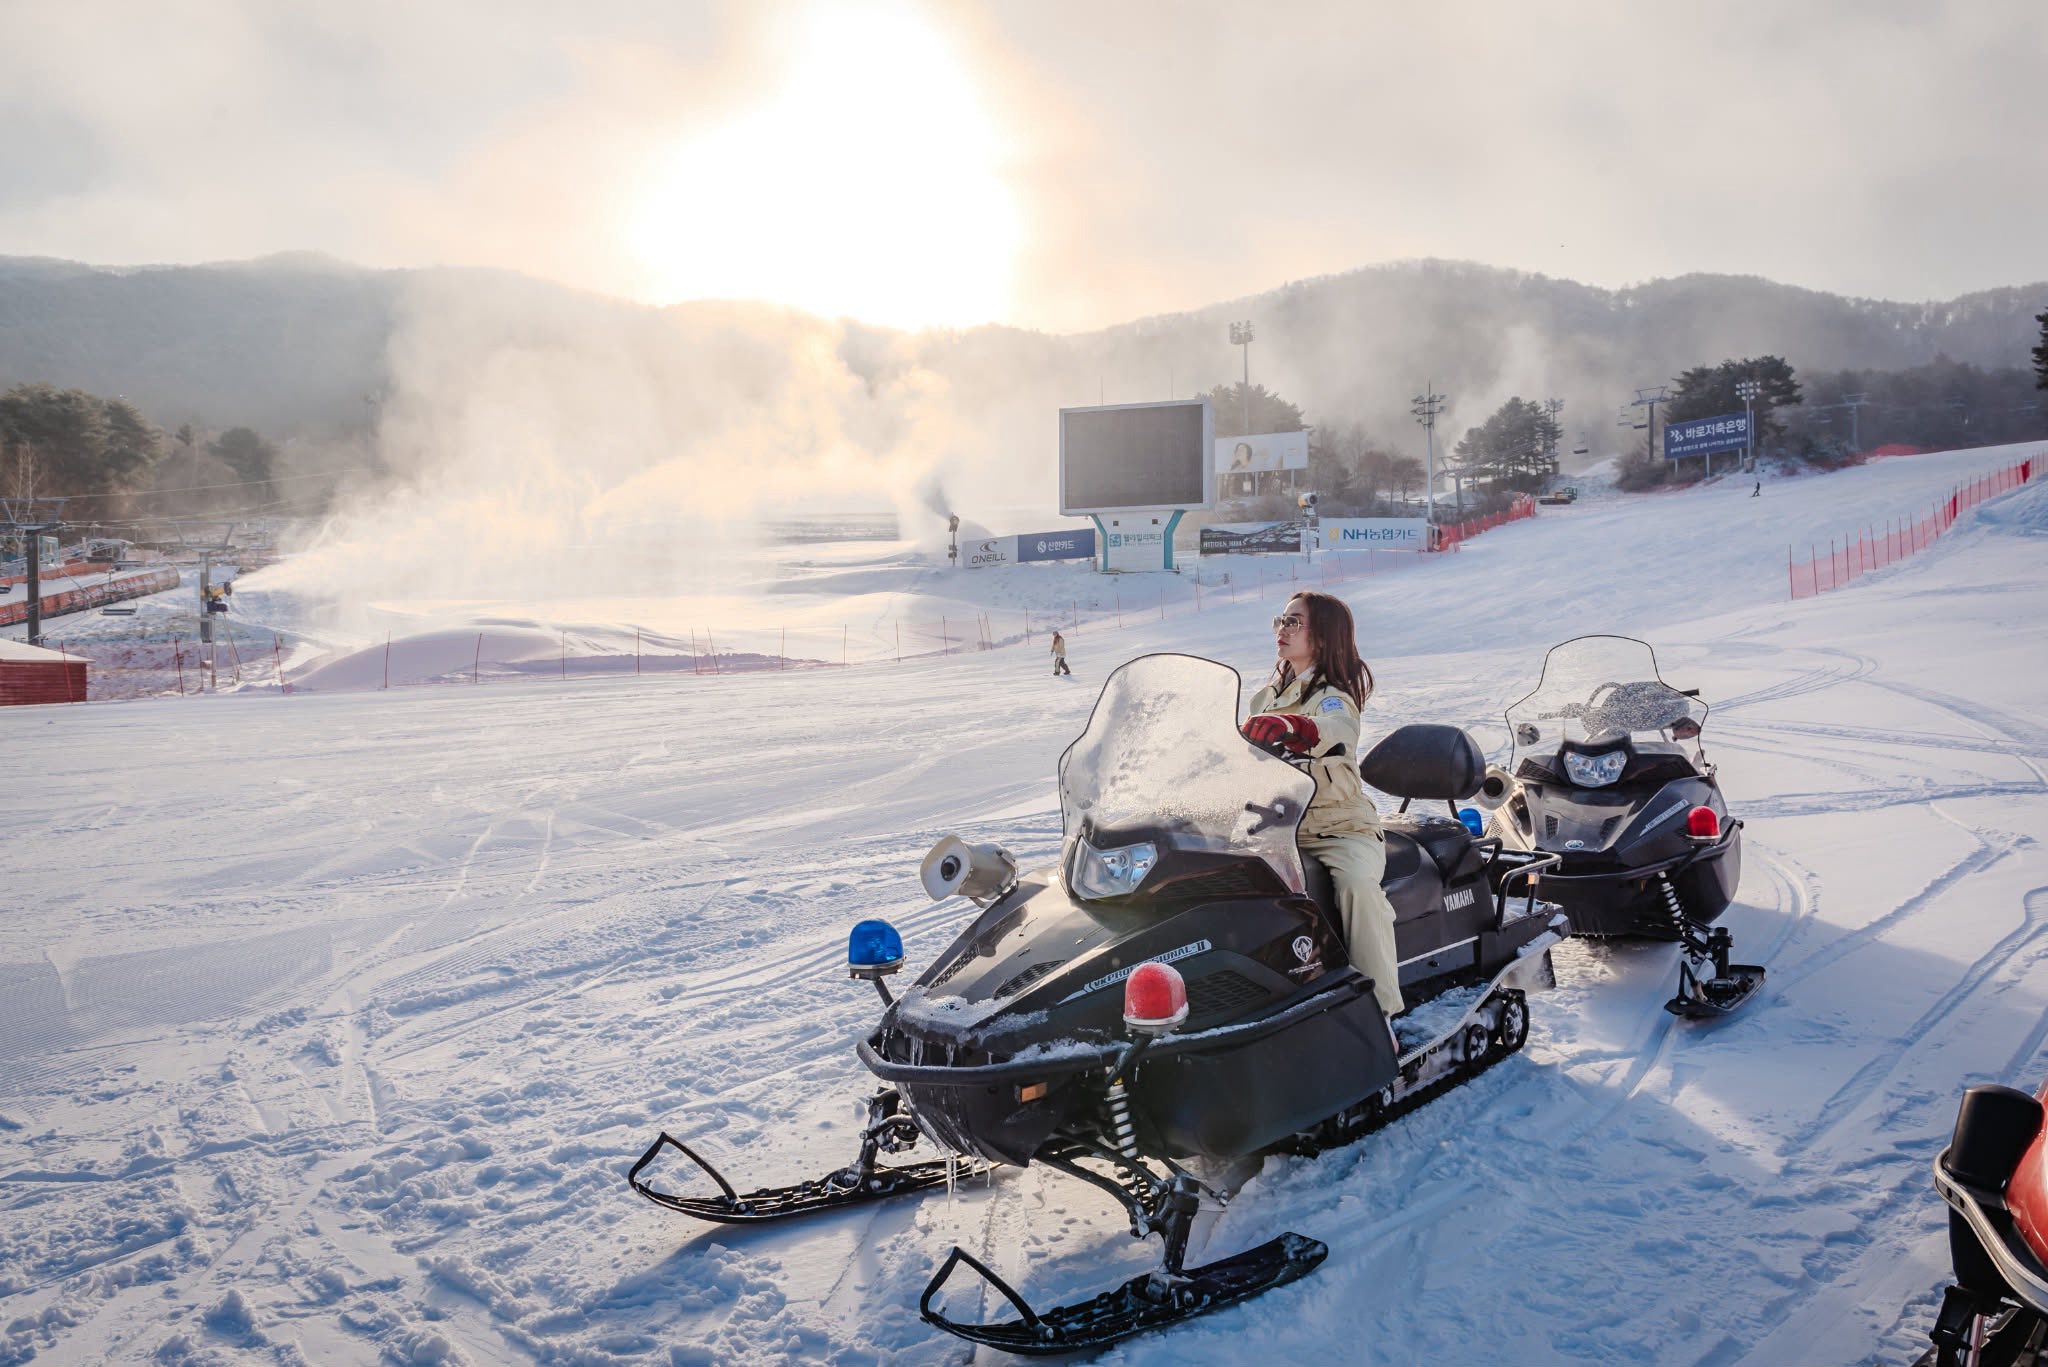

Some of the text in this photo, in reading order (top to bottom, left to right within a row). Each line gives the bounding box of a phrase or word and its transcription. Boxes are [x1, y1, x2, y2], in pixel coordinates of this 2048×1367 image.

[1685, 418, 1746, 439] 바로저축은행
[1343, 528, 1418, 541] NH농협카드
[1047, 540, 1076, 552] 신한카드
[1443, 888, 1475, 913] YAMAHA
